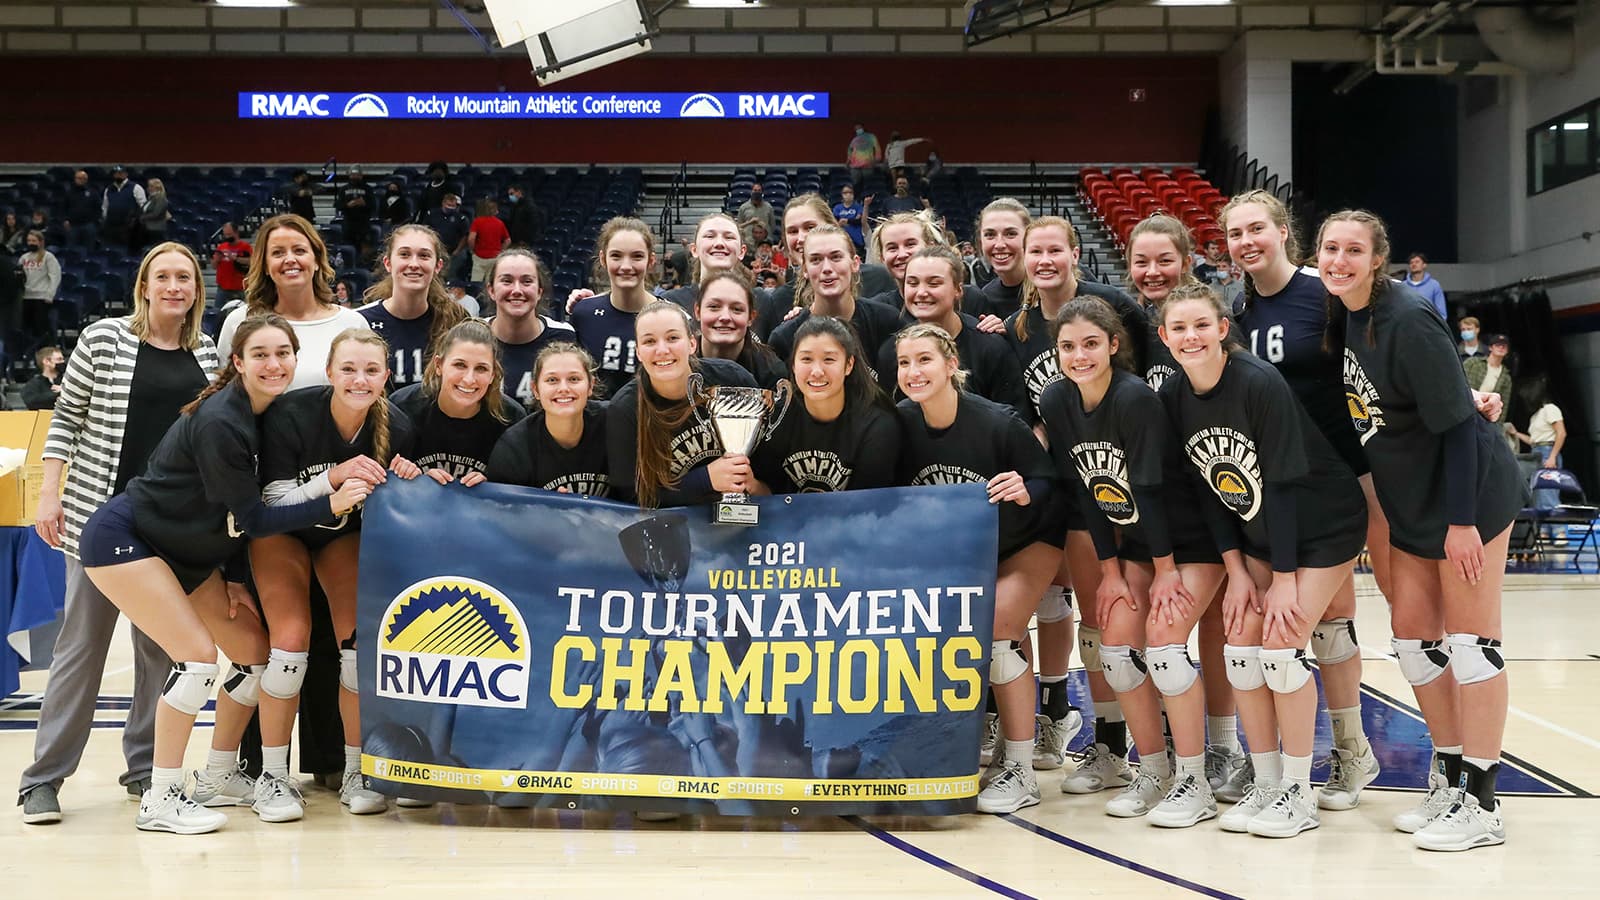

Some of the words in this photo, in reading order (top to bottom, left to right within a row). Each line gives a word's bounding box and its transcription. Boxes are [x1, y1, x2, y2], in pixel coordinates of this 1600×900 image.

[251, 94, 329, 116] RMAC
[407, 96, 449, 118] Rocky
[454, 96, 520, 114] Mountain
[525, 96, 578, 114] Athletic
[582, 96, 662, 114] Conference
[738, 94, 816, 116] RMAC
[602, 336, 636, 373] 21
[1250, 324, 1285, 364] 16
[394, 348, 424, 384] 11
[568, 472, 596, 483] ATHLETIC
[747, 541, 806, 566] 2021
[708, 567, 842, 590] VOLLEYBALL
[557, 586, 984, 638] TOURNAMENT
[380, 653, 524, 703] RMAC
[549, 635, 983, 715] CHAMPIONS
[517, 775, 573, 790] @RMAC
[581, 777, 639, 792] SPORTS
[677, 780, 720, 795] RMAC
[727, 781, 785, 796] SPORTS
[803, 779, 976, 797] #EVERYTHINGELEVATED
